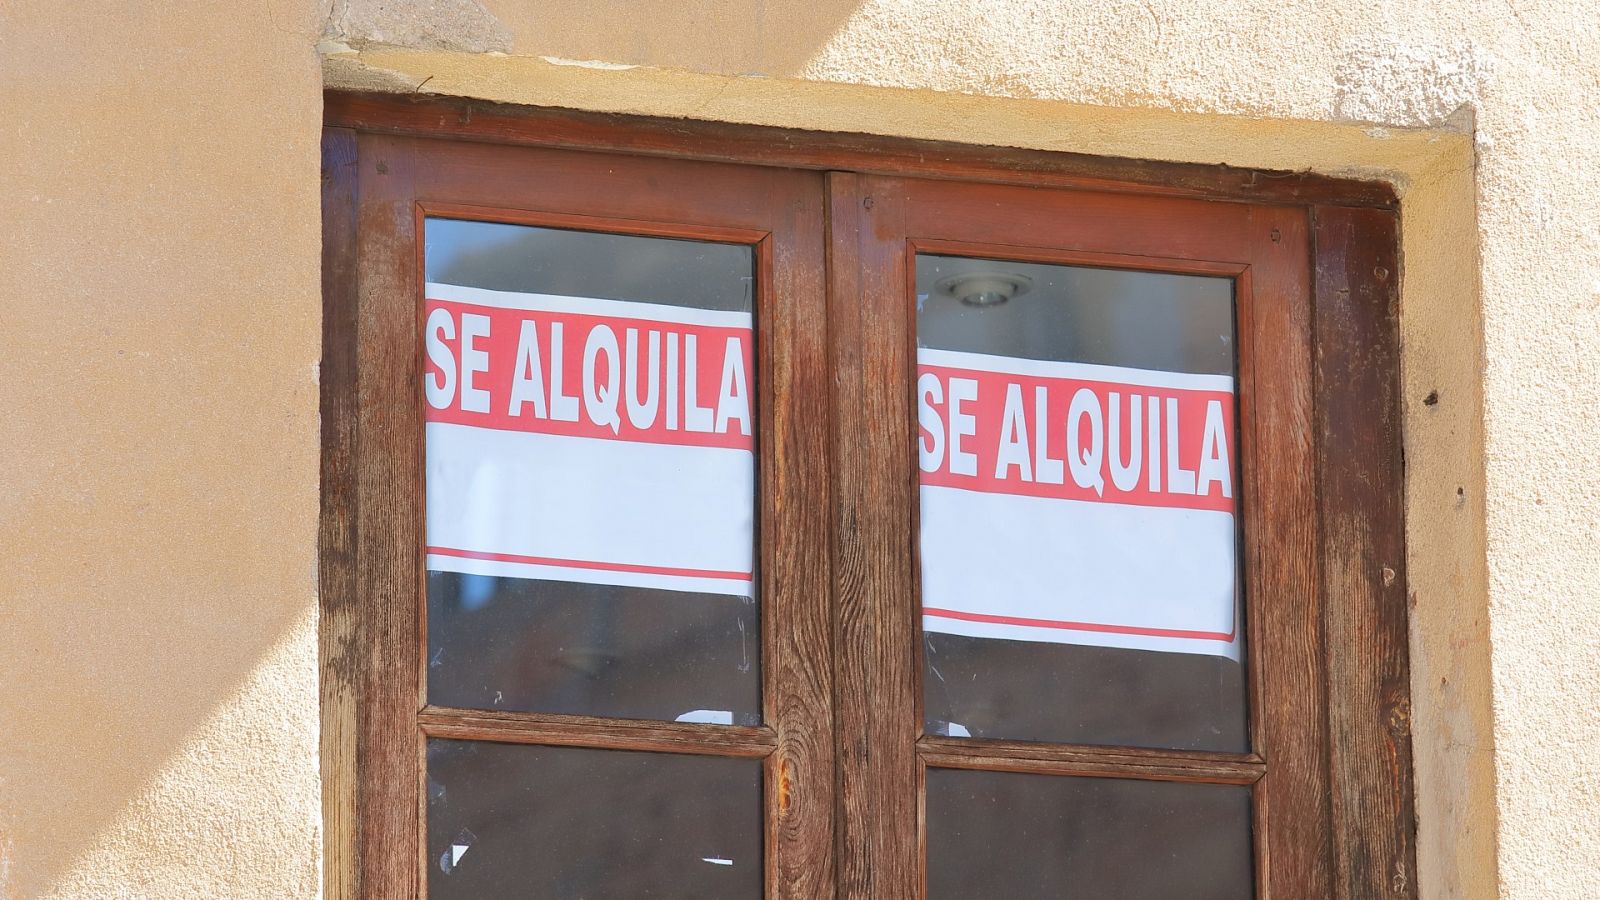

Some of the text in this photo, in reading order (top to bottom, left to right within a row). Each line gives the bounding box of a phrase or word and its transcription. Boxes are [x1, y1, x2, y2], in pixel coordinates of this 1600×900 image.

[425, 308, 752, 436] SE ALQUILA
[918, 372, 1233, 498] SE ALQUILA
